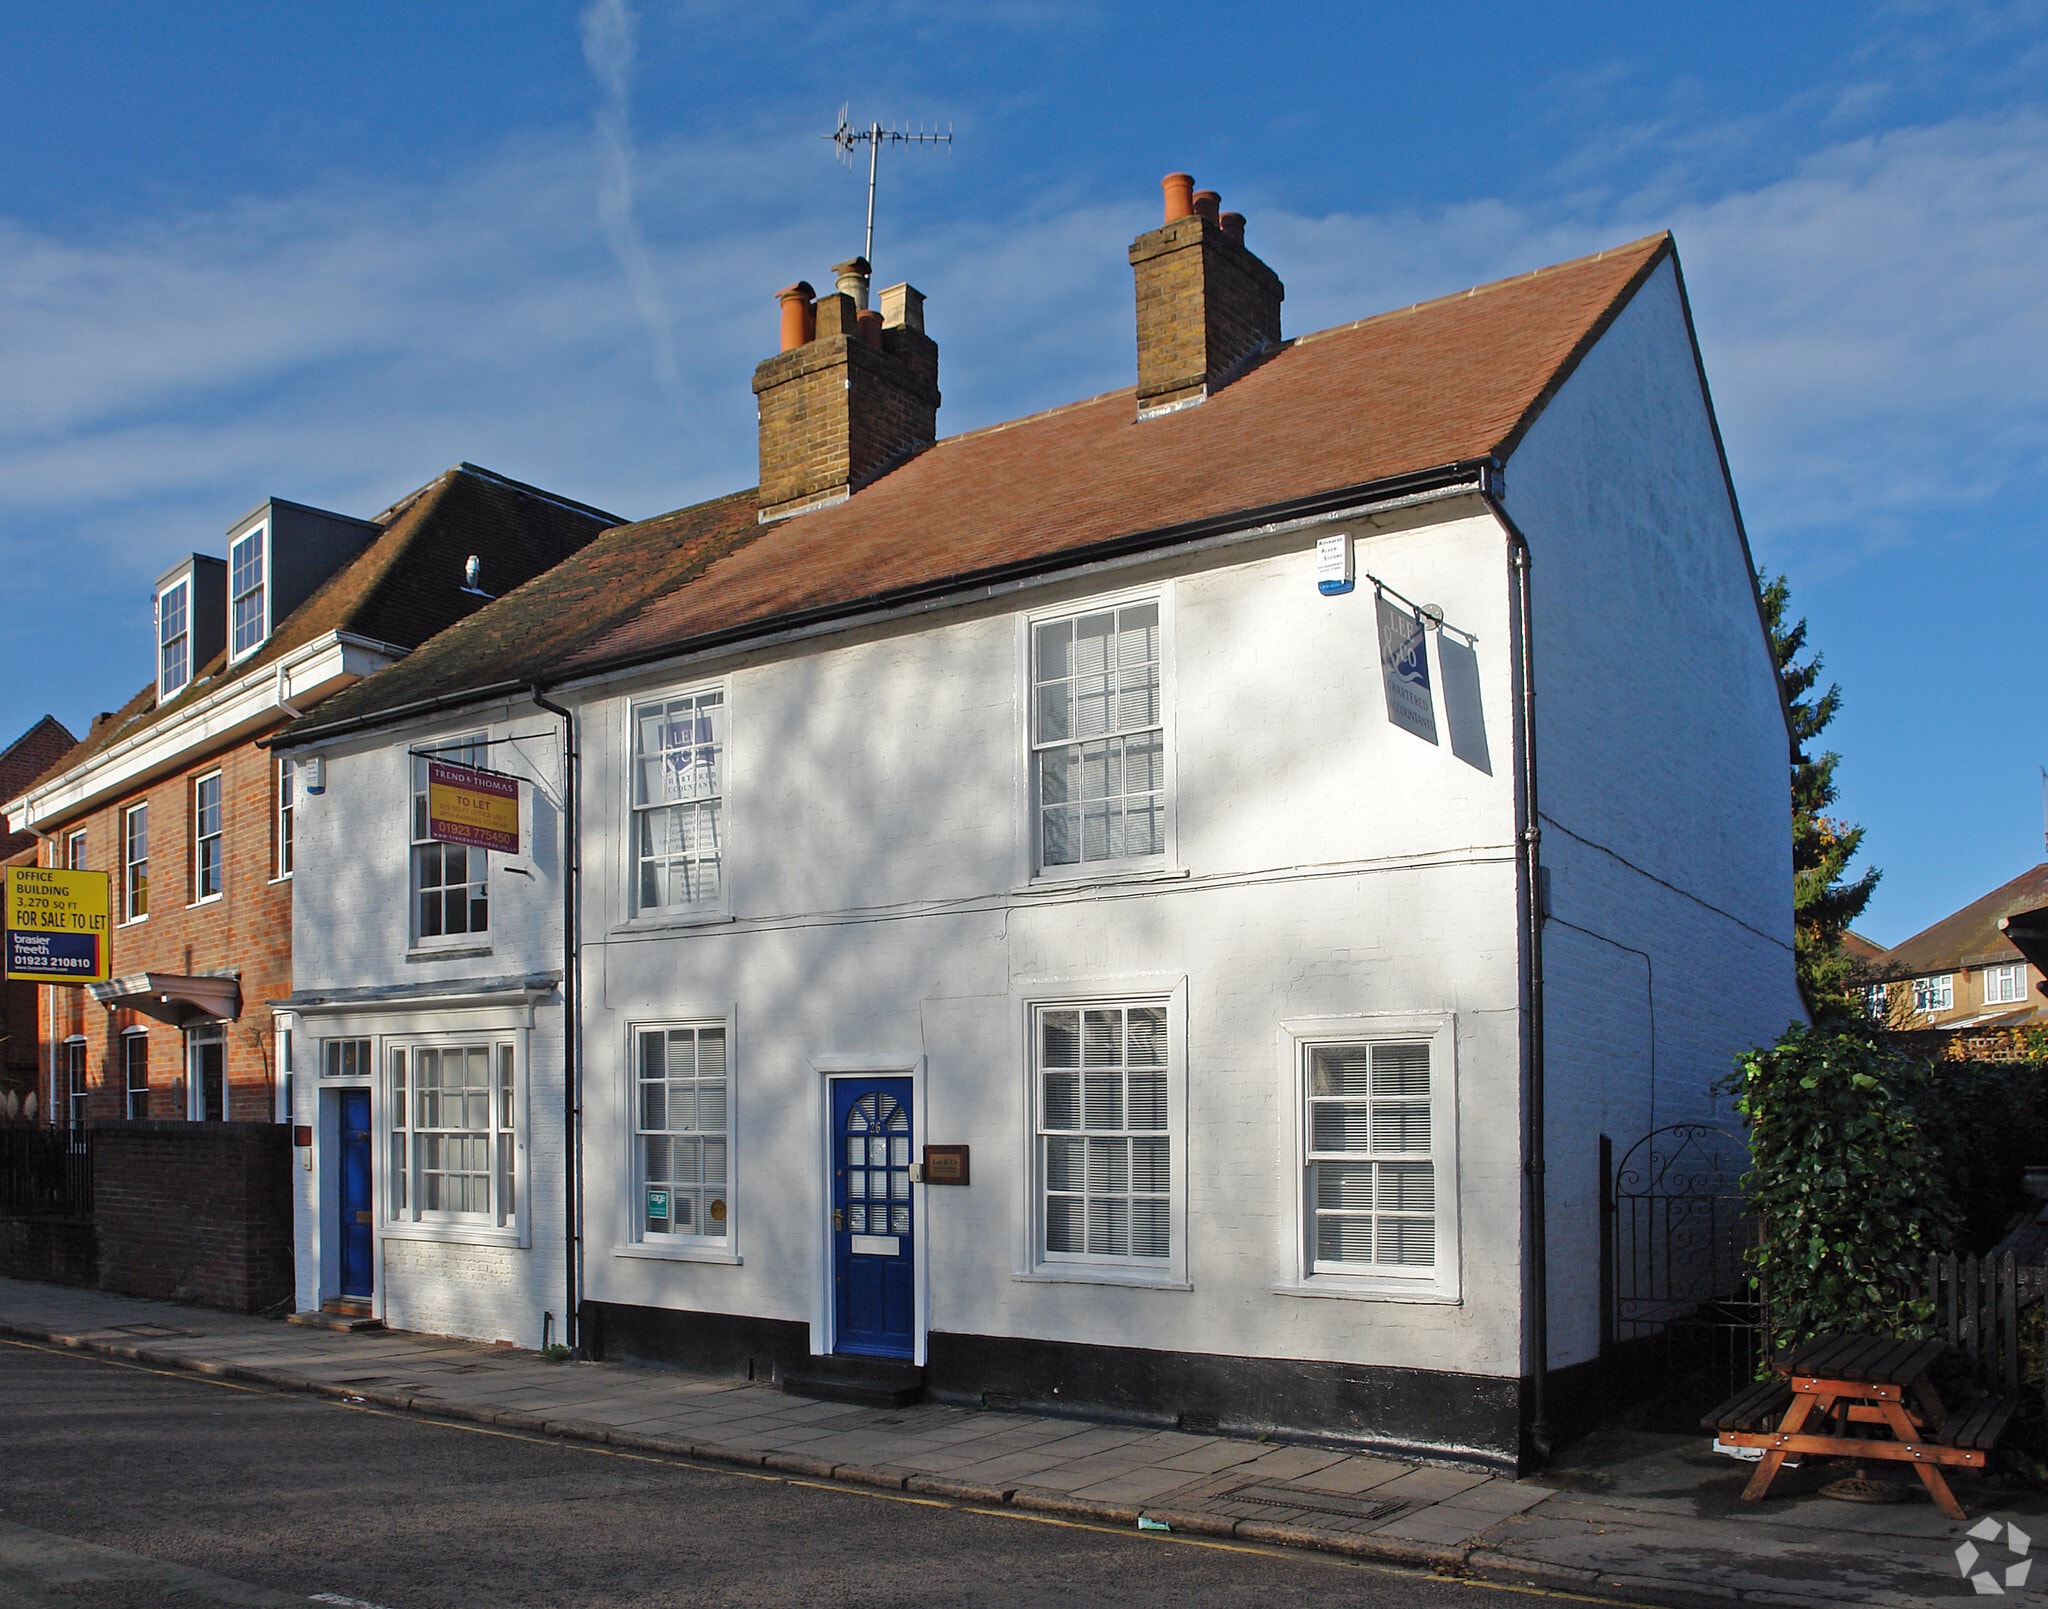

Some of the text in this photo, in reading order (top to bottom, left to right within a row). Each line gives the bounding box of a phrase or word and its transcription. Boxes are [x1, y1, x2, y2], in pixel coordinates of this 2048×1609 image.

[1389, 611, 1414, 643] LEE
[435, 769, 465, 782] TREND
[474, 777, 514, 792] THOMAS
[456, 796, 491, 811] TO LET
[439, 822, 511, 845] 01923 775450
[16, 871, 54, 882] OFFICE
[16, 884, 70, 896] BUILDING
[17, 897, 78, 910] 3,270 SQ FT
[17, 910, 37, 926] FOR
[89, 914, 106, 930] LET
[13, 933, 51, 945] brasier
[14, 944, 50, 955] freeth
[14, 955, 91, 968] 01923 210810
